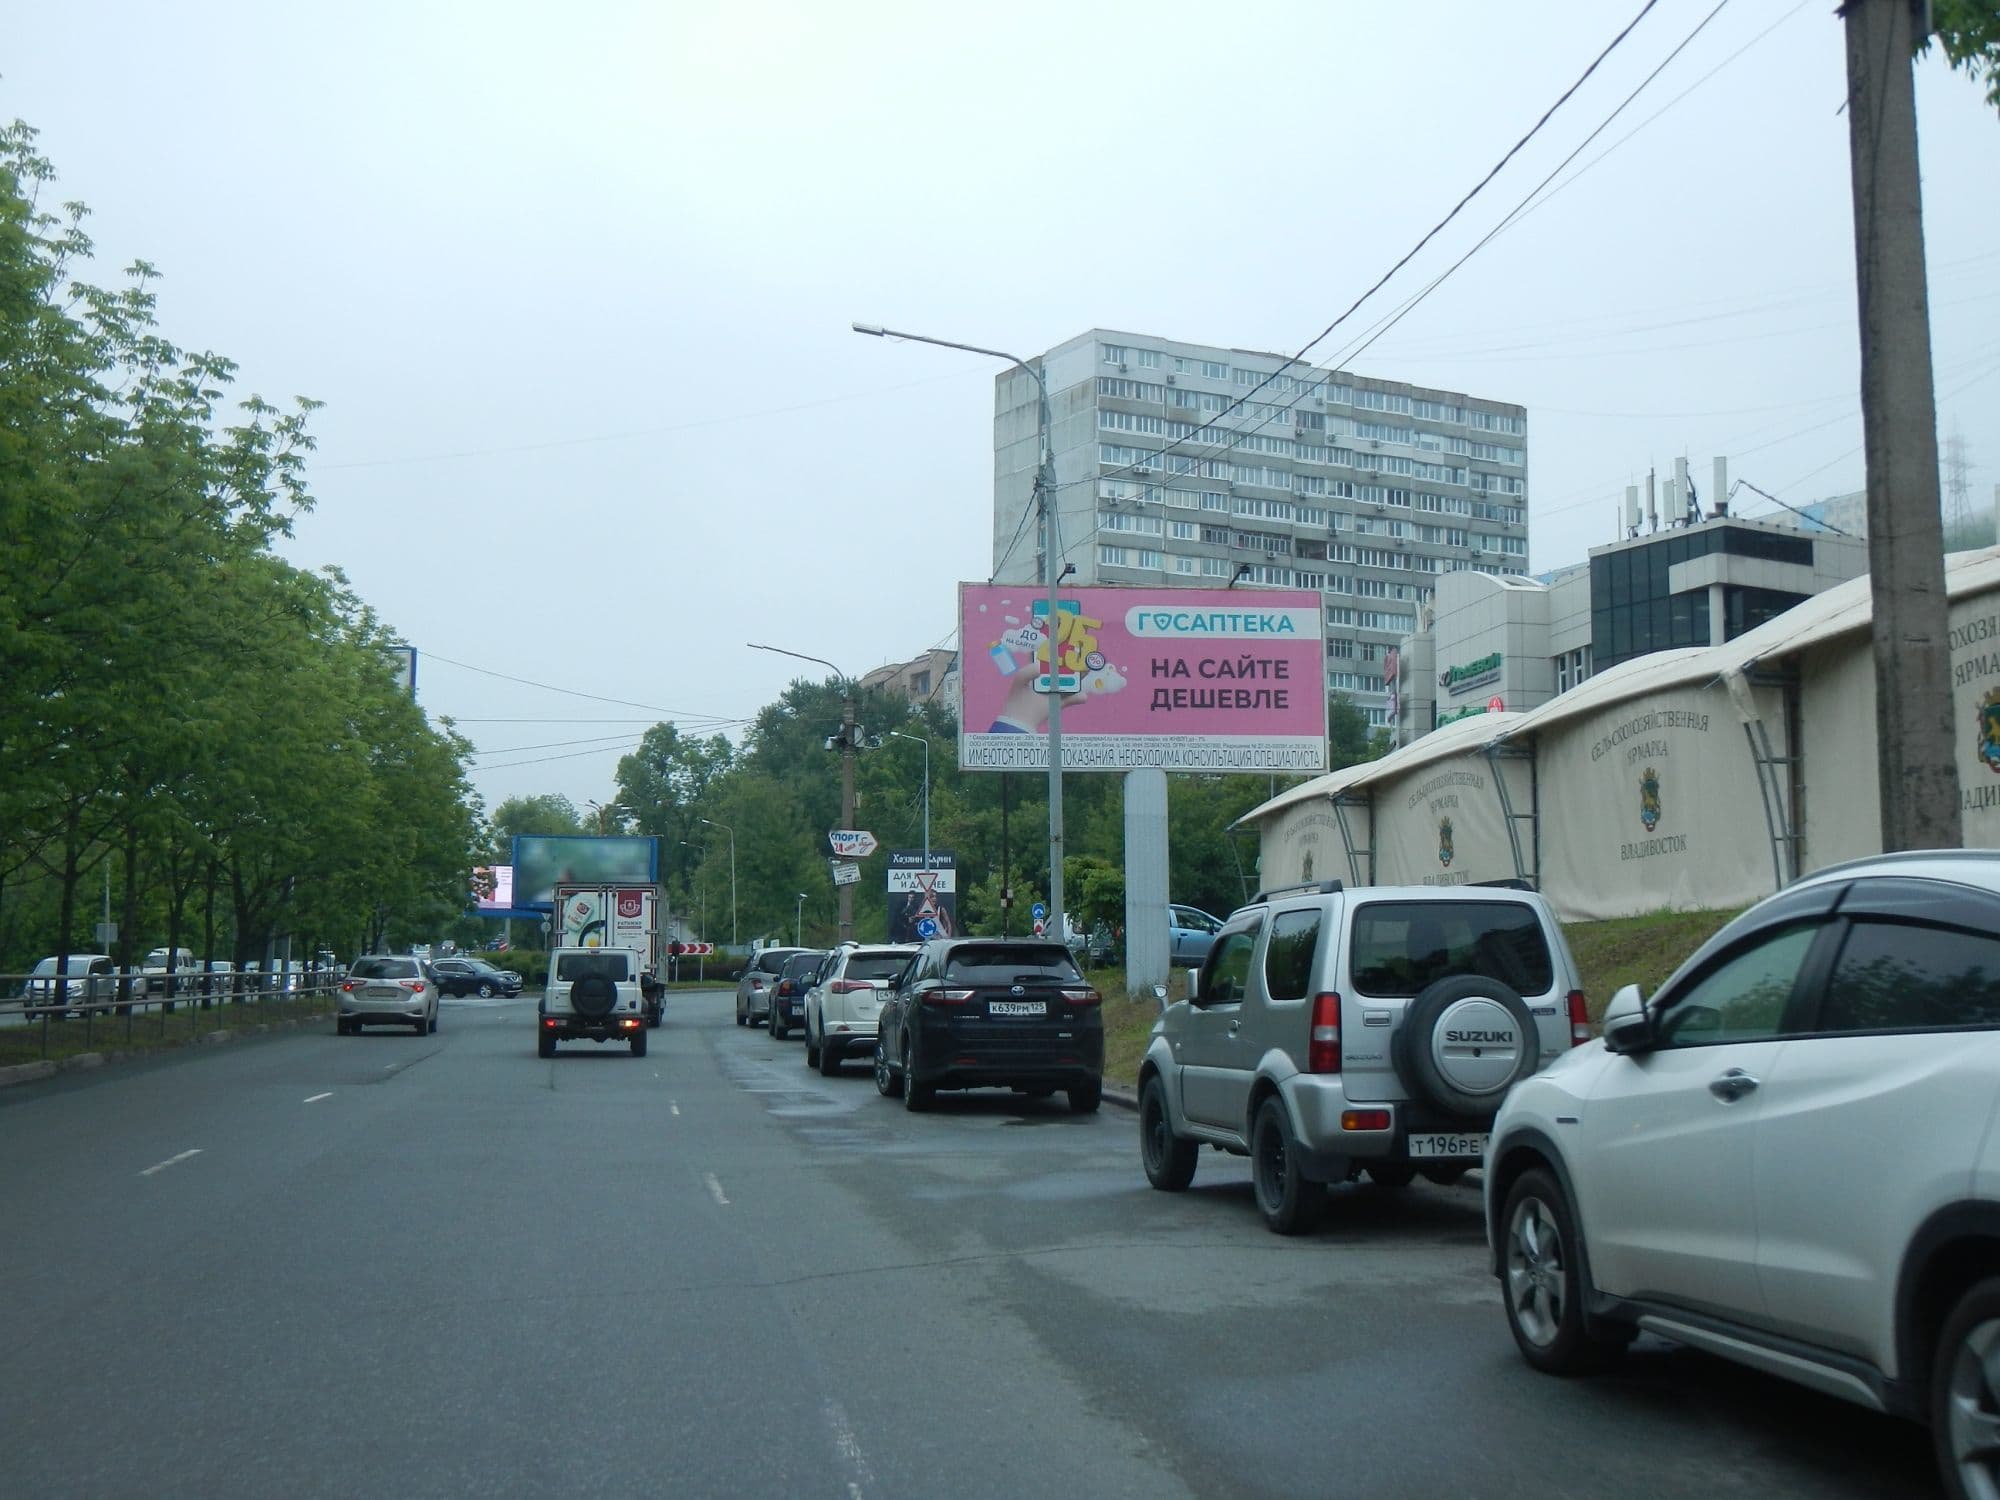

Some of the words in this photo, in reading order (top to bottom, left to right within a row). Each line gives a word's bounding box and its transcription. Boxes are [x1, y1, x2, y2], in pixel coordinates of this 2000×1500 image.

[1138, 613, 1295, 633] ГОСАПТЕКА
[1020, 629, 1038, 641] ДО
[1151, 658, 1191, 678] НА
[1198, 654, 1290, 679] САЙТЕ
[1150, 688, 1290, 711] ДЕШЕВЛЕ
[969, 748, 1014, 765] ИМЕЮТСЯ
[1016, 748, 1118, 766] ПРОТИПОКАЗАНИЯ,
[1119, 749, 1179, 767] НЕОБХОДИМА
[1183, 750, 1251, 767] КОНСУЛЬТАЦИЯ
[1255, 750, 1320, 768] СПЕЦИАЛИСТА
[1627, 740, 1669, 766] ЯРМАРКА
[831, 832, 860, 842] СПОРТ
[1620, 834, 1688, 861] ВЛАДИВОСТОК
[893, 872, 911, 880] ДЛЯ
[1446, 1030, 1513, 1043] SUZUKI
[1415, 1136, 1479, 1154] Т196РЕ
